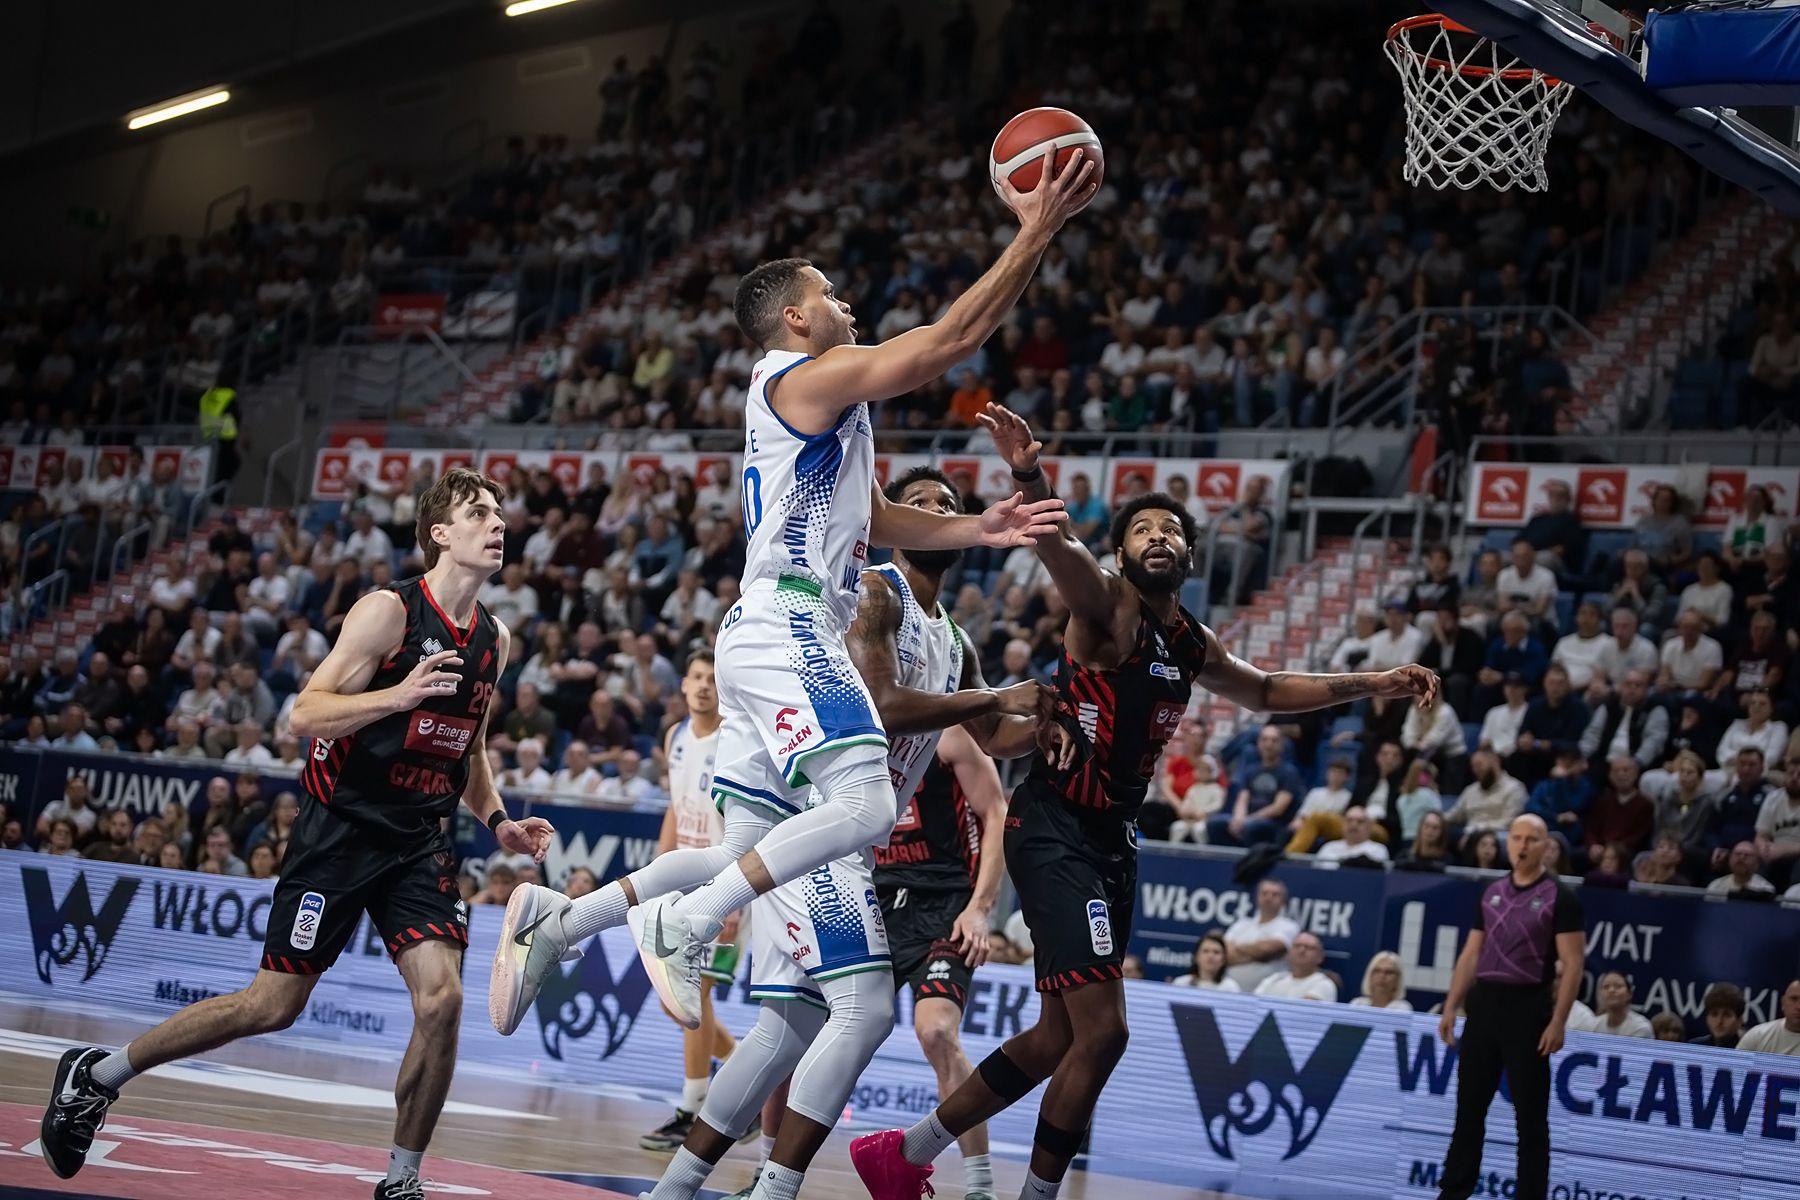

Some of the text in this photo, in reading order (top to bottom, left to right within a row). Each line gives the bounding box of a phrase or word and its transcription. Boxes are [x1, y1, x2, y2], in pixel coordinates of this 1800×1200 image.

[436, 723, 470, 741] Energa
[778, 725, 812, 755] ORLEN
[389, 763, 455, 795] CZAR
[303, 899, 321, 908] PGE
[1091, 906, 1105, 914] PGE
[1141, 881, 1355, 938] WŁOCŁWEK
[294, 931, 313, 941] Basket
[1147, 946, 1193, 968] Miast
[310, 1000, 386, 1033] klimatu
